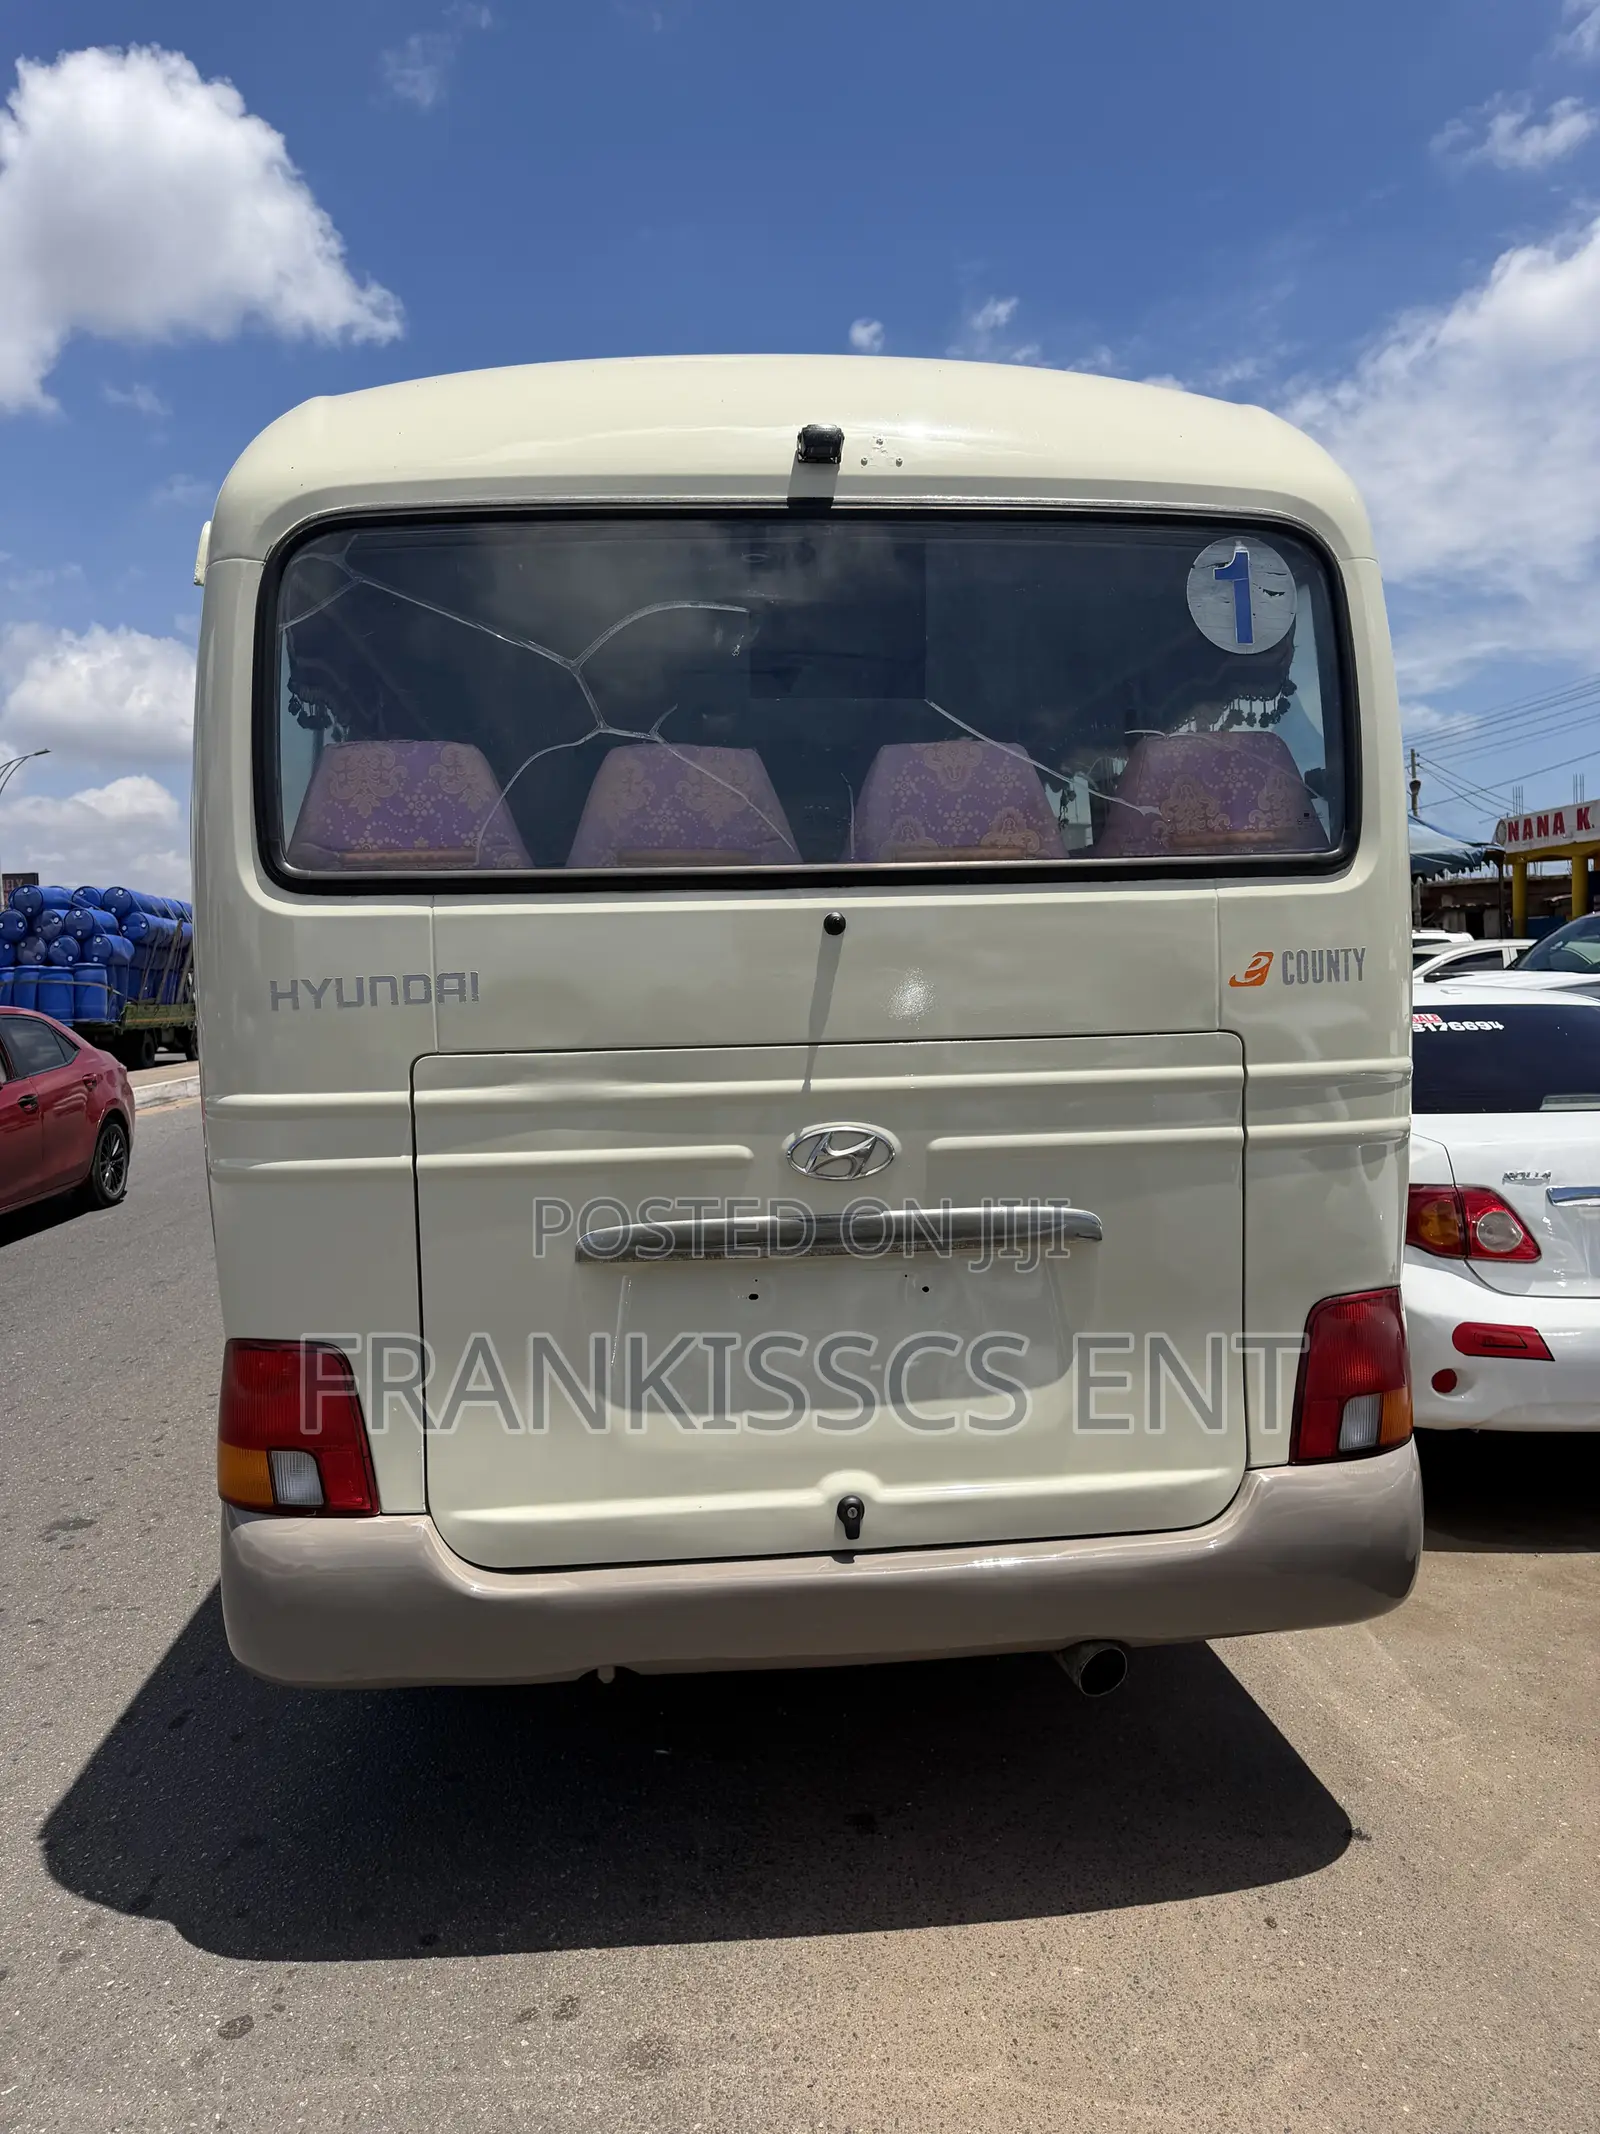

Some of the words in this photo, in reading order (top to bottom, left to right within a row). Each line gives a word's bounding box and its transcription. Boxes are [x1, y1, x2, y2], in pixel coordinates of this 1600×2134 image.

[1213, 549, 1254, 645] 1
[1508, 811, 1566, 842] NANA
[1281, 947, 1366, 986] COUNTY
[269, 970, 479, 1011] HYUNDAI
